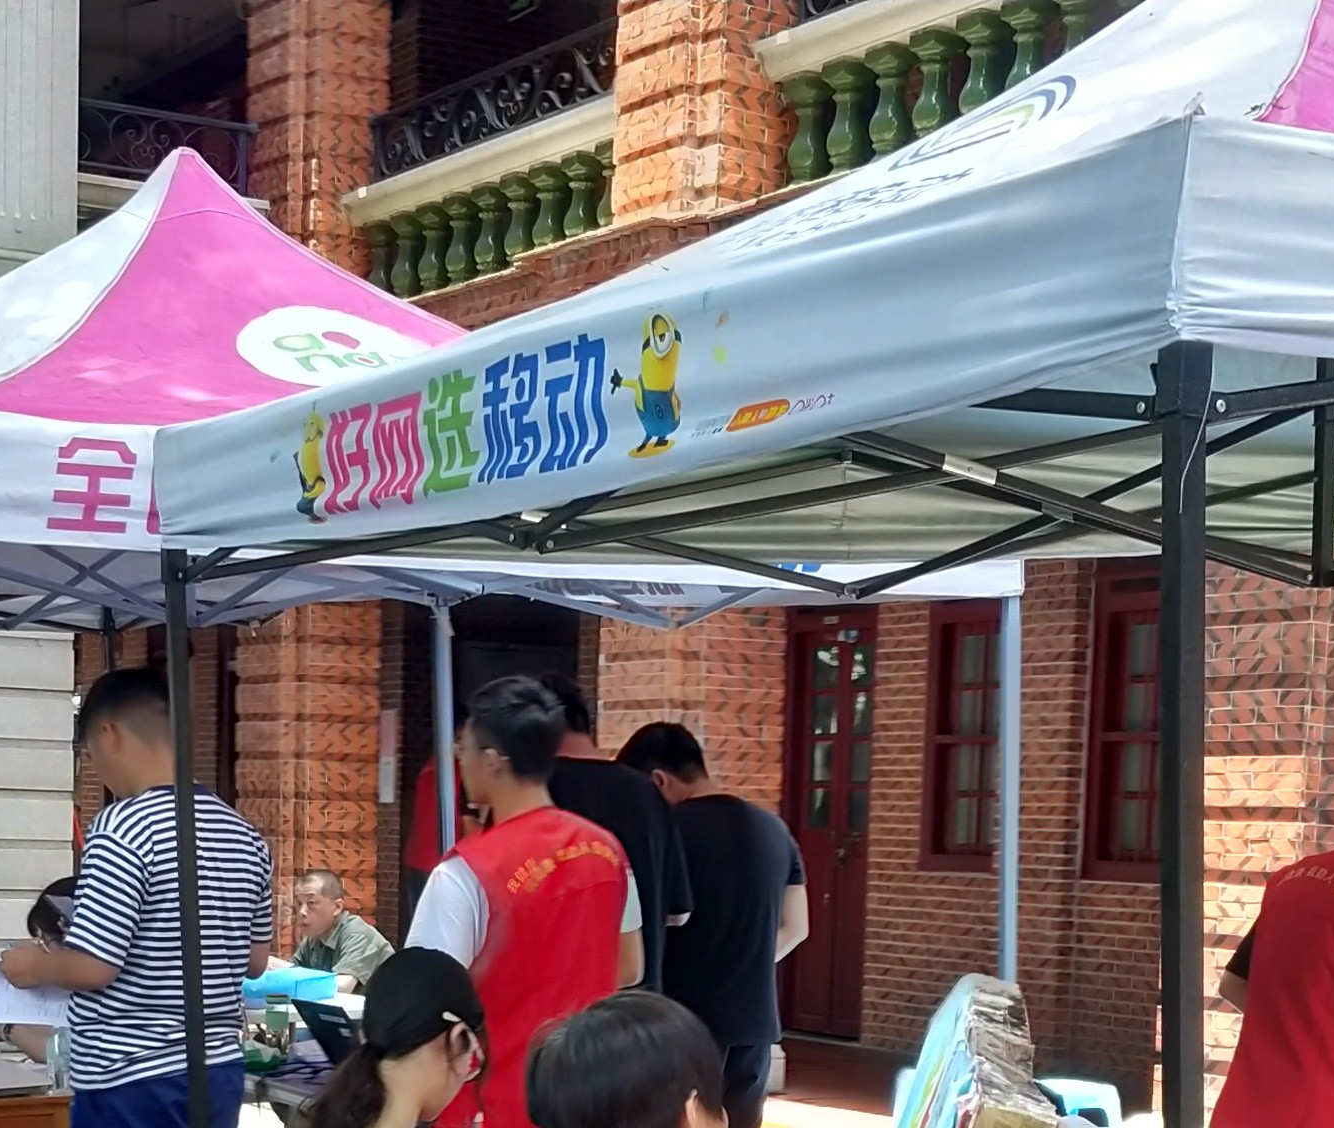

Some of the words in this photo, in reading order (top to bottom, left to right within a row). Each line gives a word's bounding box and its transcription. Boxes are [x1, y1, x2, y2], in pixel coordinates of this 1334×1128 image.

[46, 437, 161, 535] 全
[324, 333, 608, 515] 好网选移动
